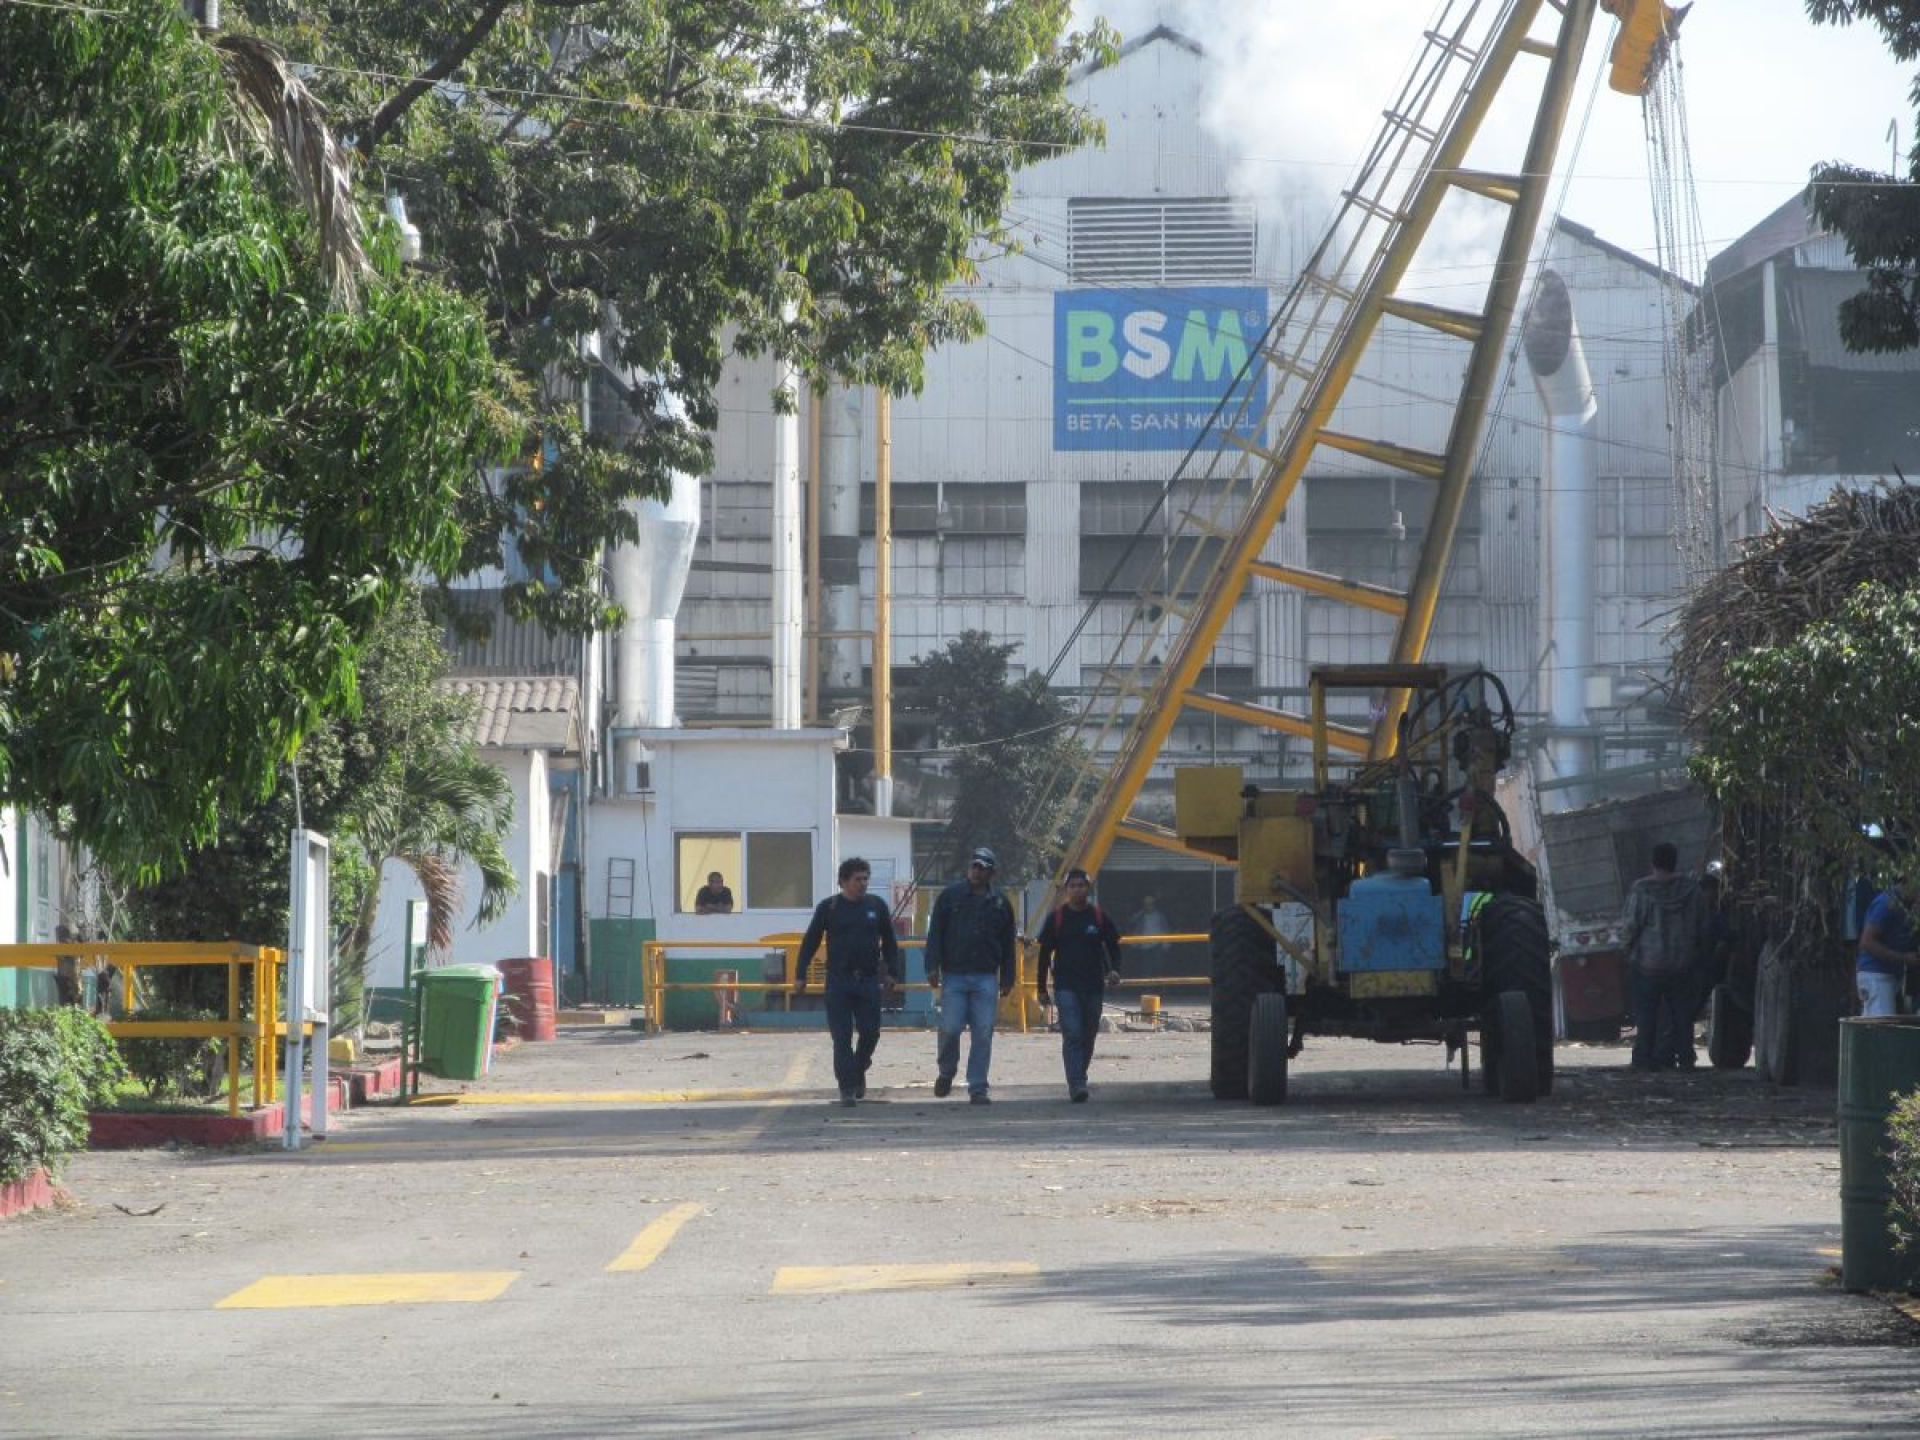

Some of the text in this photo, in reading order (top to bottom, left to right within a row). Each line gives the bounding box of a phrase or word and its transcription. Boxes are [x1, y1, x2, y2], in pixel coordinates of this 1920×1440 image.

[1066, 309, 1252, 383] BSM
[1066, 413, 1123, 431] BETA
[1130, 411, 1179, 431] SAN
